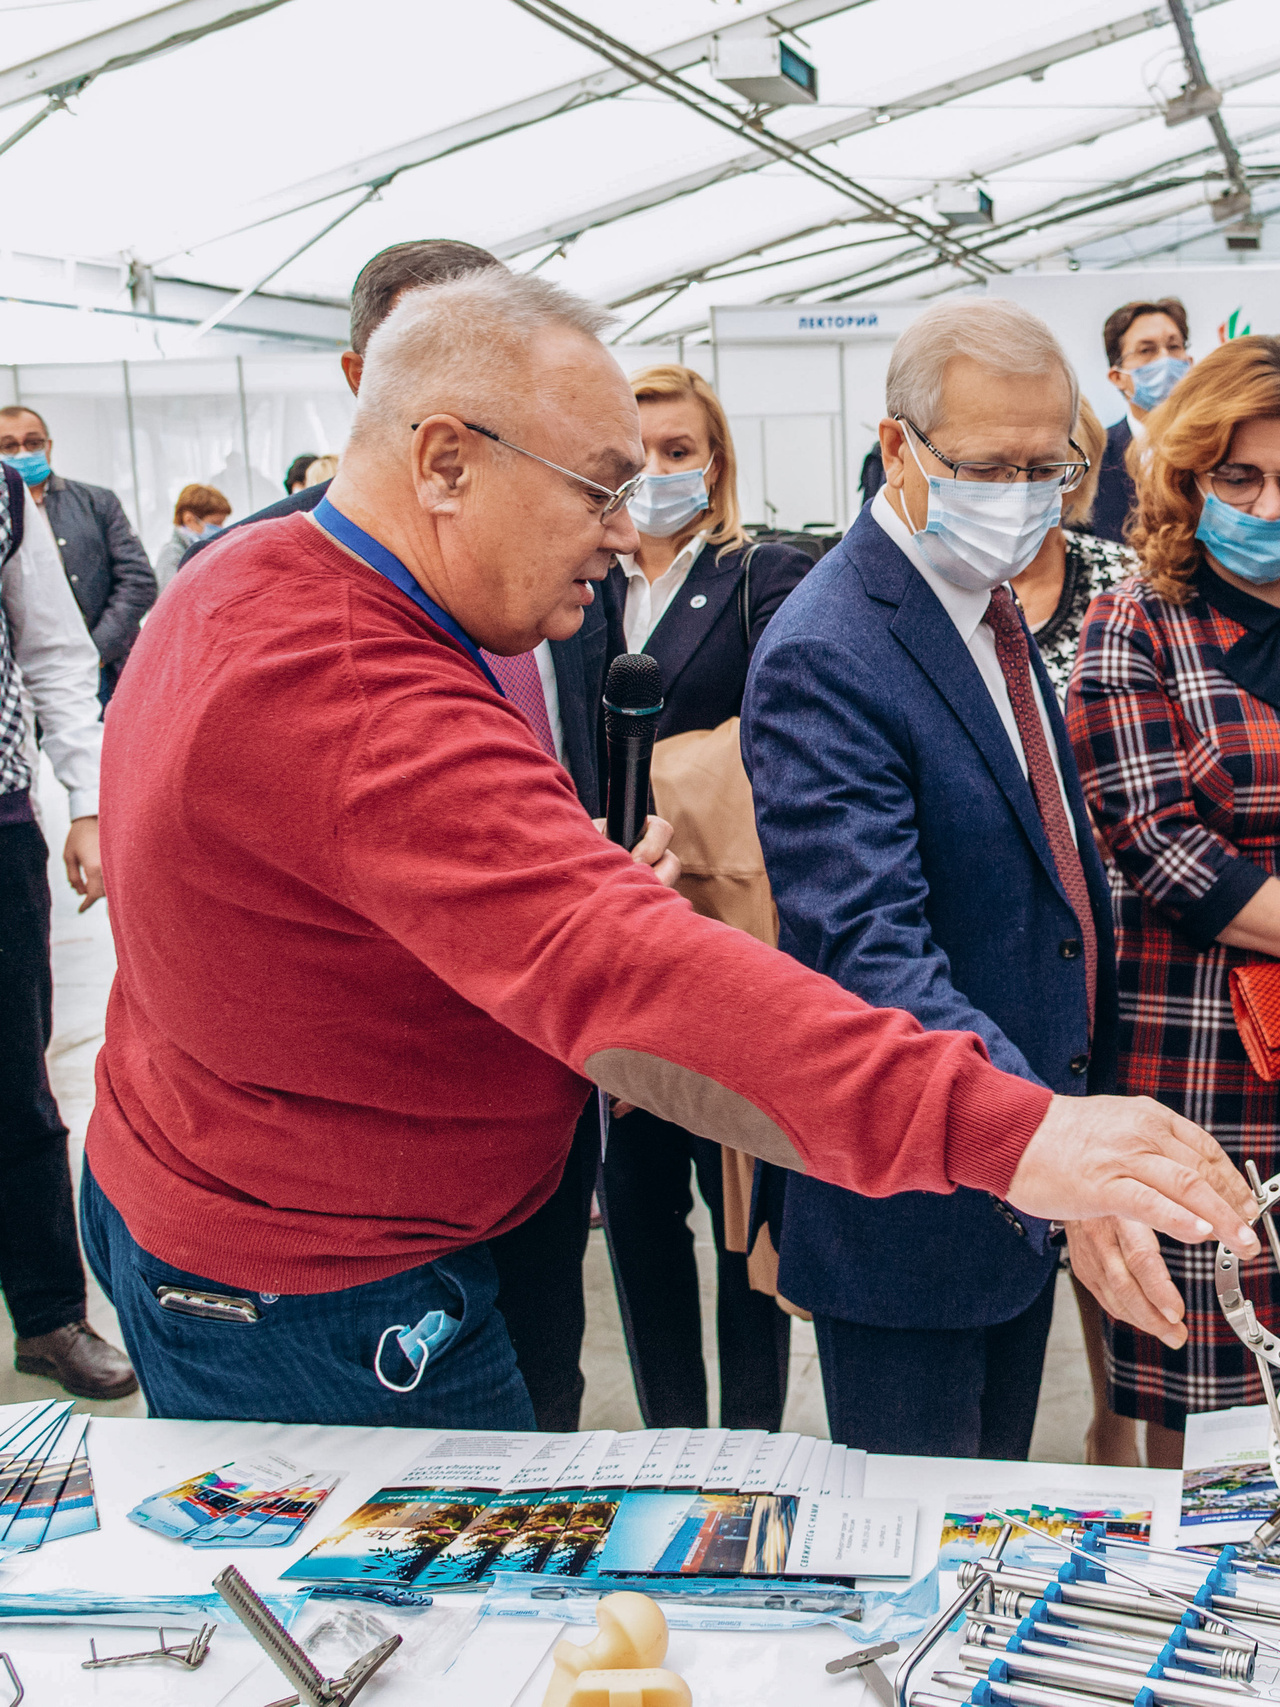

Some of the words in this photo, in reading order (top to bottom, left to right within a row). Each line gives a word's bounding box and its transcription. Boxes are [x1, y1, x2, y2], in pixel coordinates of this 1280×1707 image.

[798, 313, 879, 329] ЛЕКТОРИЙ
[800, 1530, 815, 1567] СВЯЖИТЕСЬ
[809, 1503, 819, 1522] НАМИ
